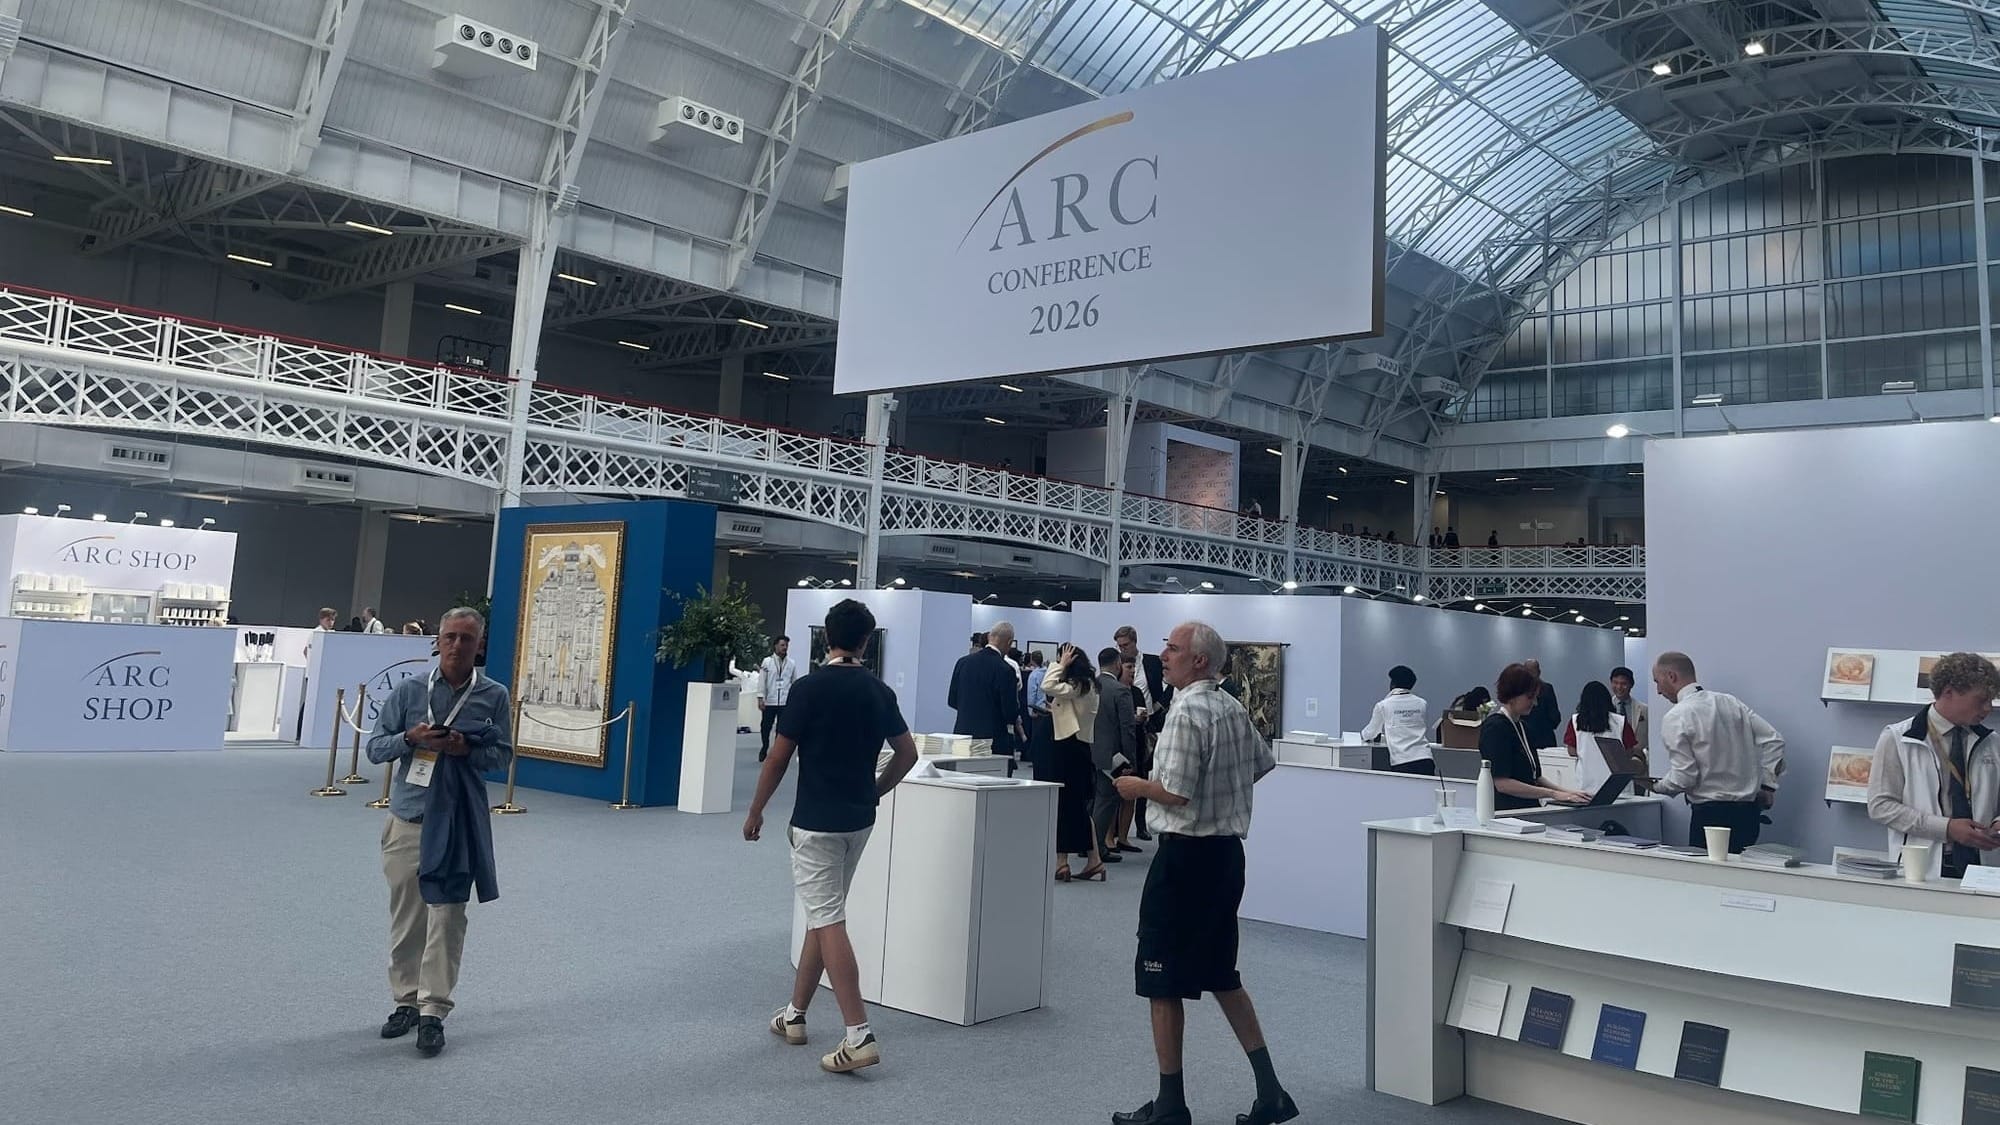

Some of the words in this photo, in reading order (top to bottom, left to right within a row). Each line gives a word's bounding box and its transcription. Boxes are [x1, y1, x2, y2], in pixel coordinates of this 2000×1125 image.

[988, 155, 1159, 252] ARC
[987, 245, 1153, 295] CONFERENCE
[1029, 294, 1100, 336] 2026
[62, 546, 122, 567] ARC
[129, 549, 198, 572] SHOP
[95, 665, 170, 688] ARC
[84, 697, 173, 721] SHOP
